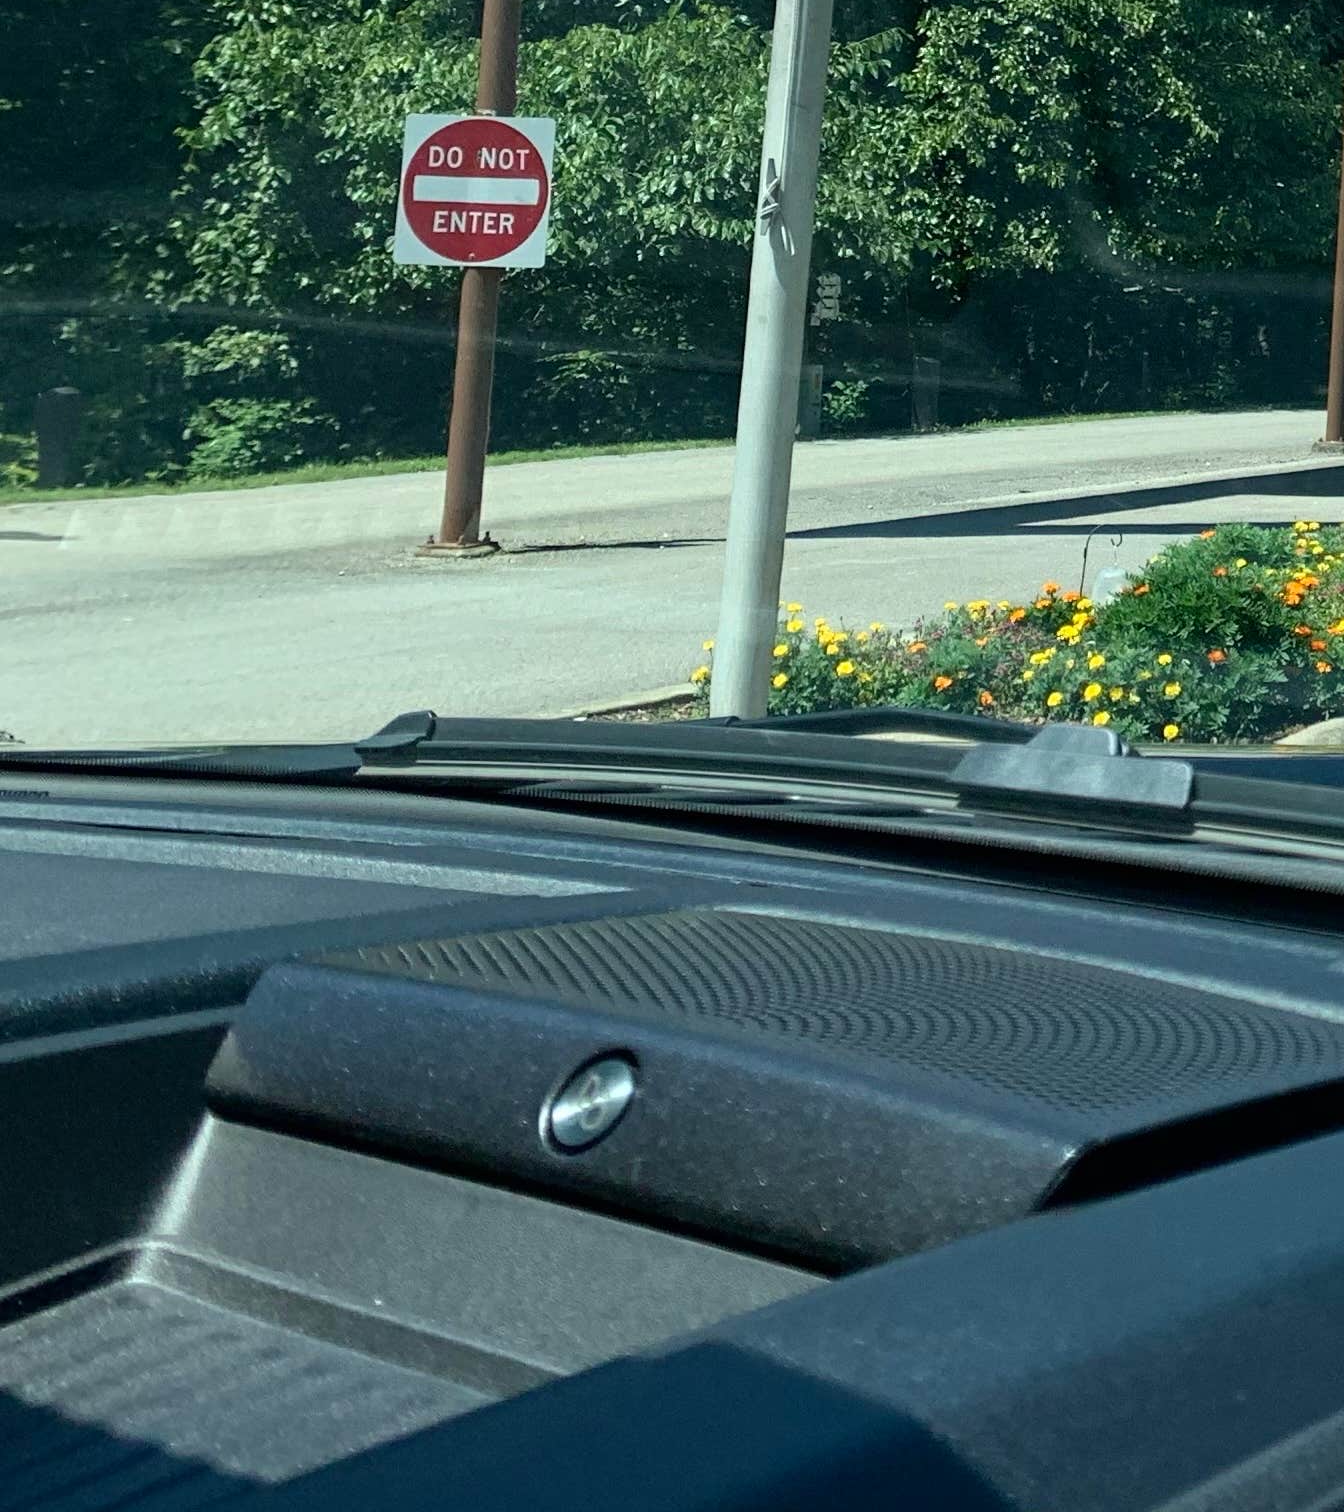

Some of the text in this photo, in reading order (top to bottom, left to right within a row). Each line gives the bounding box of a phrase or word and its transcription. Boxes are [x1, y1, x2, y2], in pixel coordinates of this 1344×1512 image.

[428, 145, 530, 170] DO NOT
[432, 210, 515, 235] ENTER
